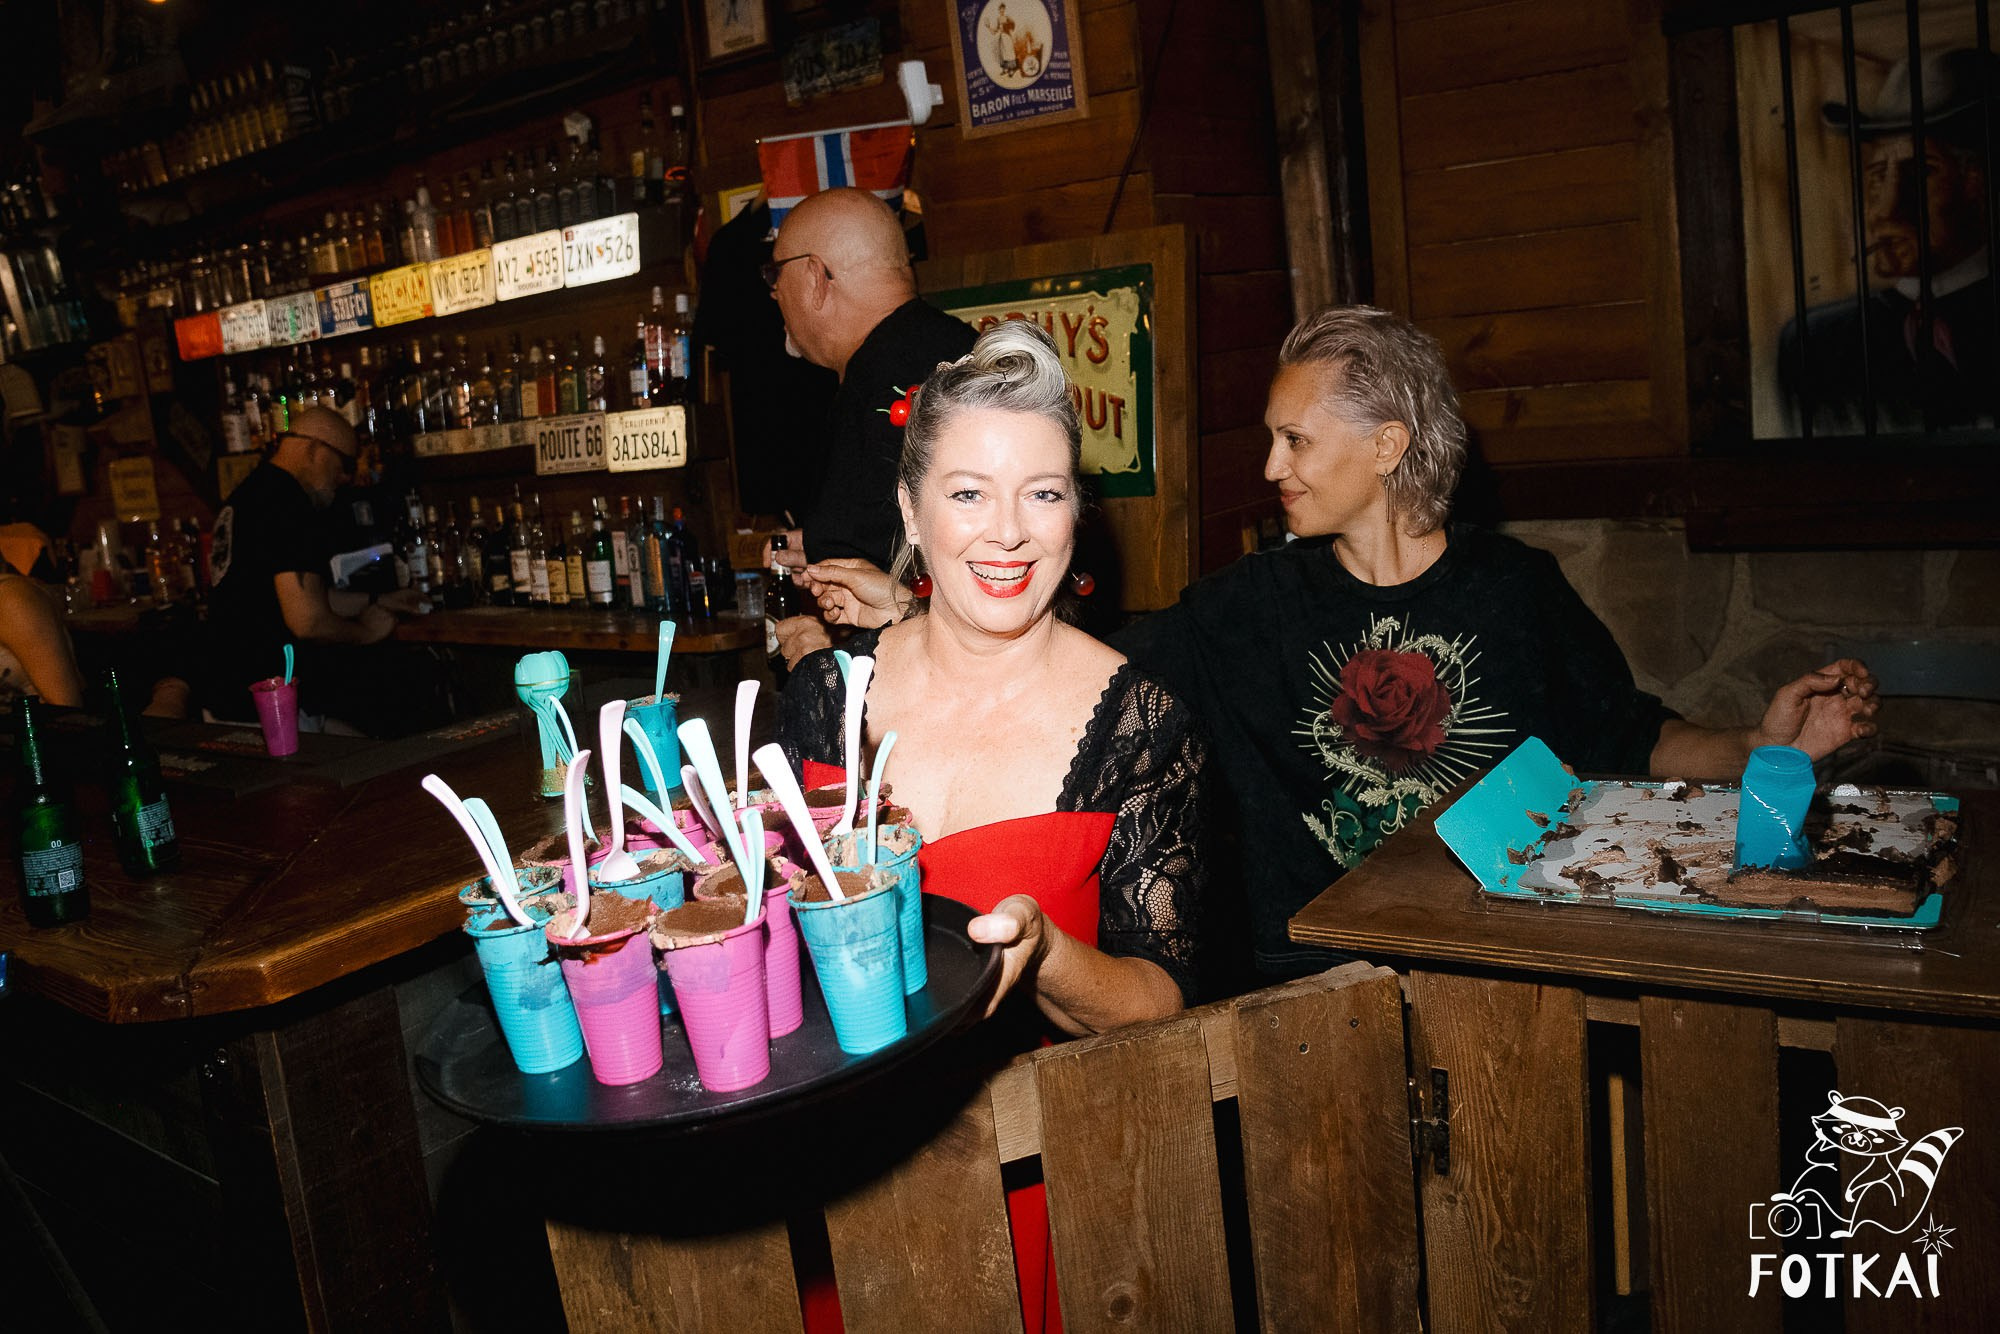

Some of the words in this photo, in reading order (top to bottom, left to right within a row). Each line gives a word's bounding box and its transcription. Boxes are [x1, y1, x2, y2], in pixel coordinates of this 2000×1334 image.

[971, 95, 1011, 118] BARON
[1027, 84, 1073, 103] MARSEILLE
[497, 257, 519, 286] AYZ
[536, 247, 559, 277] 595
[566, 243, 594, 273] ZXN
[605, 233, 633, 264] 526
[625, 417, 666, 429] CALIFORNIA
[539, 427, 580, 462] ROUTE
[585, 424, 603, 457] 66
[612, 429, 681, 462] 3AIS841
